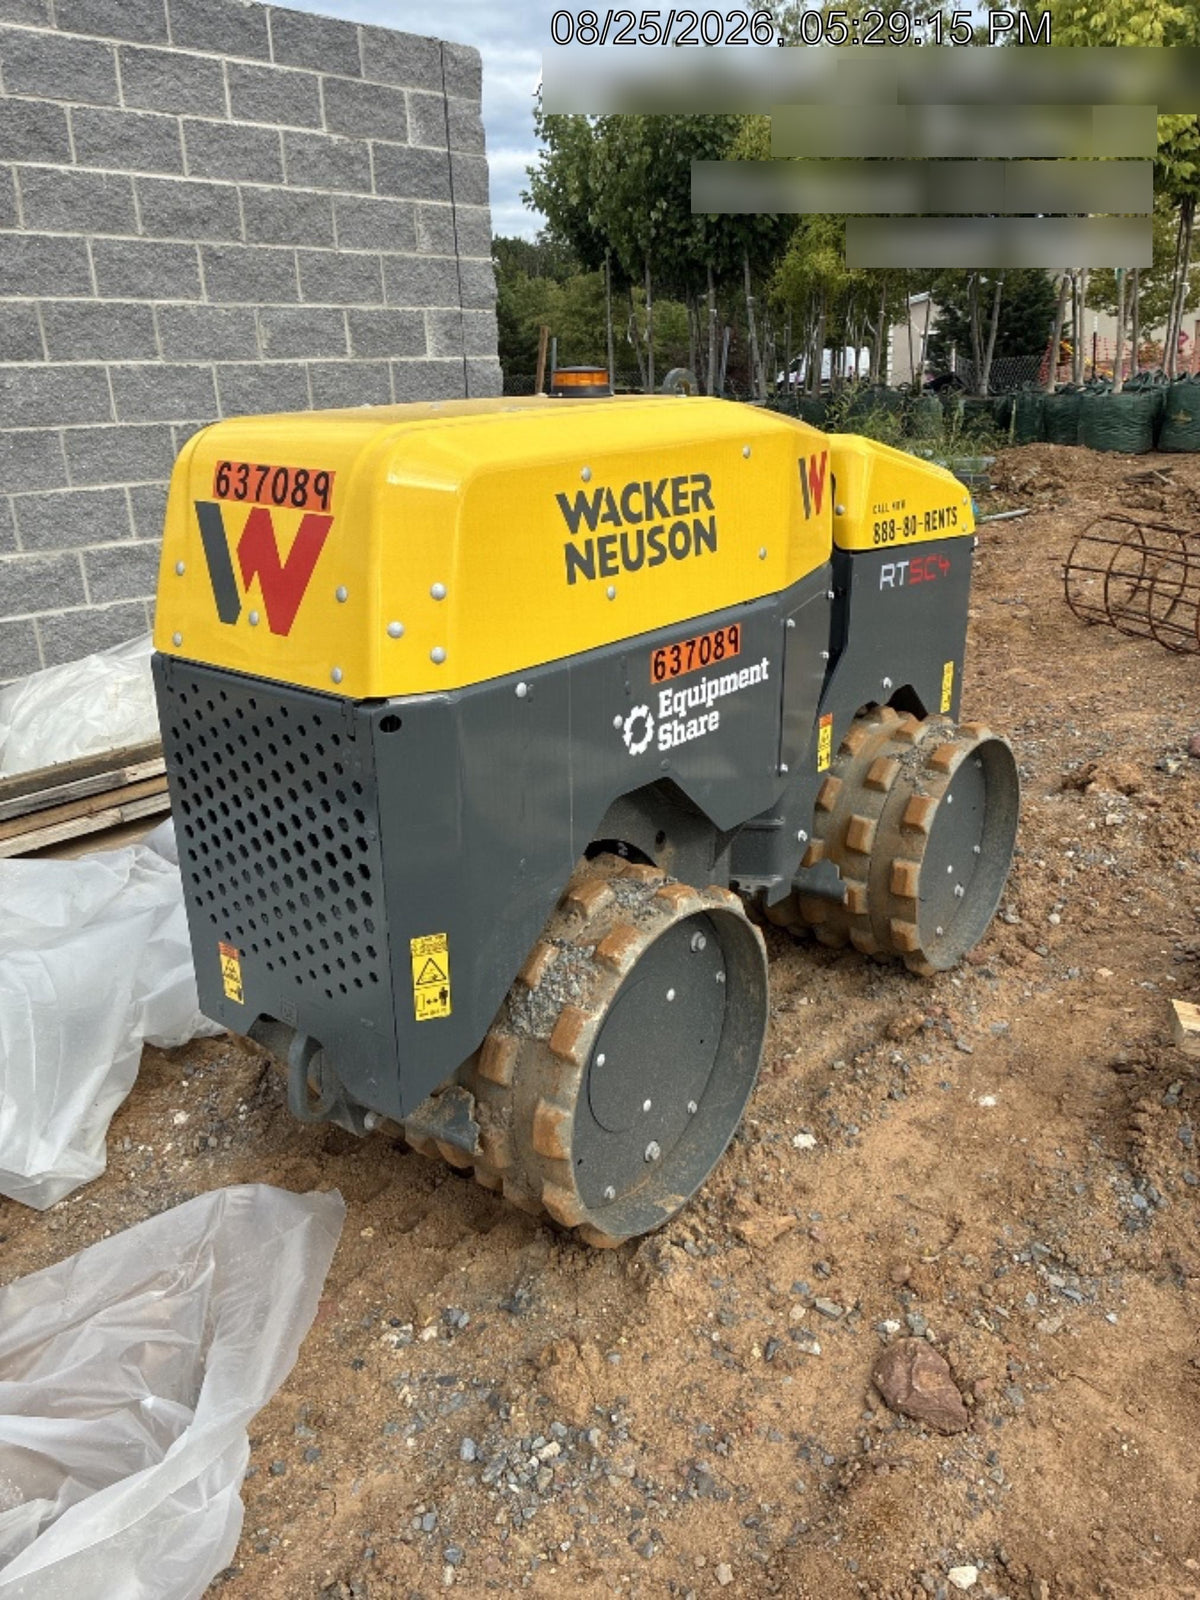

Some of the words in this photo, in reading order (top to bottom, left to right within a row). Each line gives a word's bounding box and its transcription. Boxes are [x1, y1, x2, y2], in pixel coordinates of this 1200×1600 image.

[216, 461, 330, 510] 637089
[555, 473, 715, 535] WACKER
[564, 515, 718, 585] NEUSON
[873, 506, 958, 544] 888-80-RENTS
[654, 625, 739, 681] 637089
[658, 657, 770, 718] Equipment
[658, 711, 720, 751] Share
